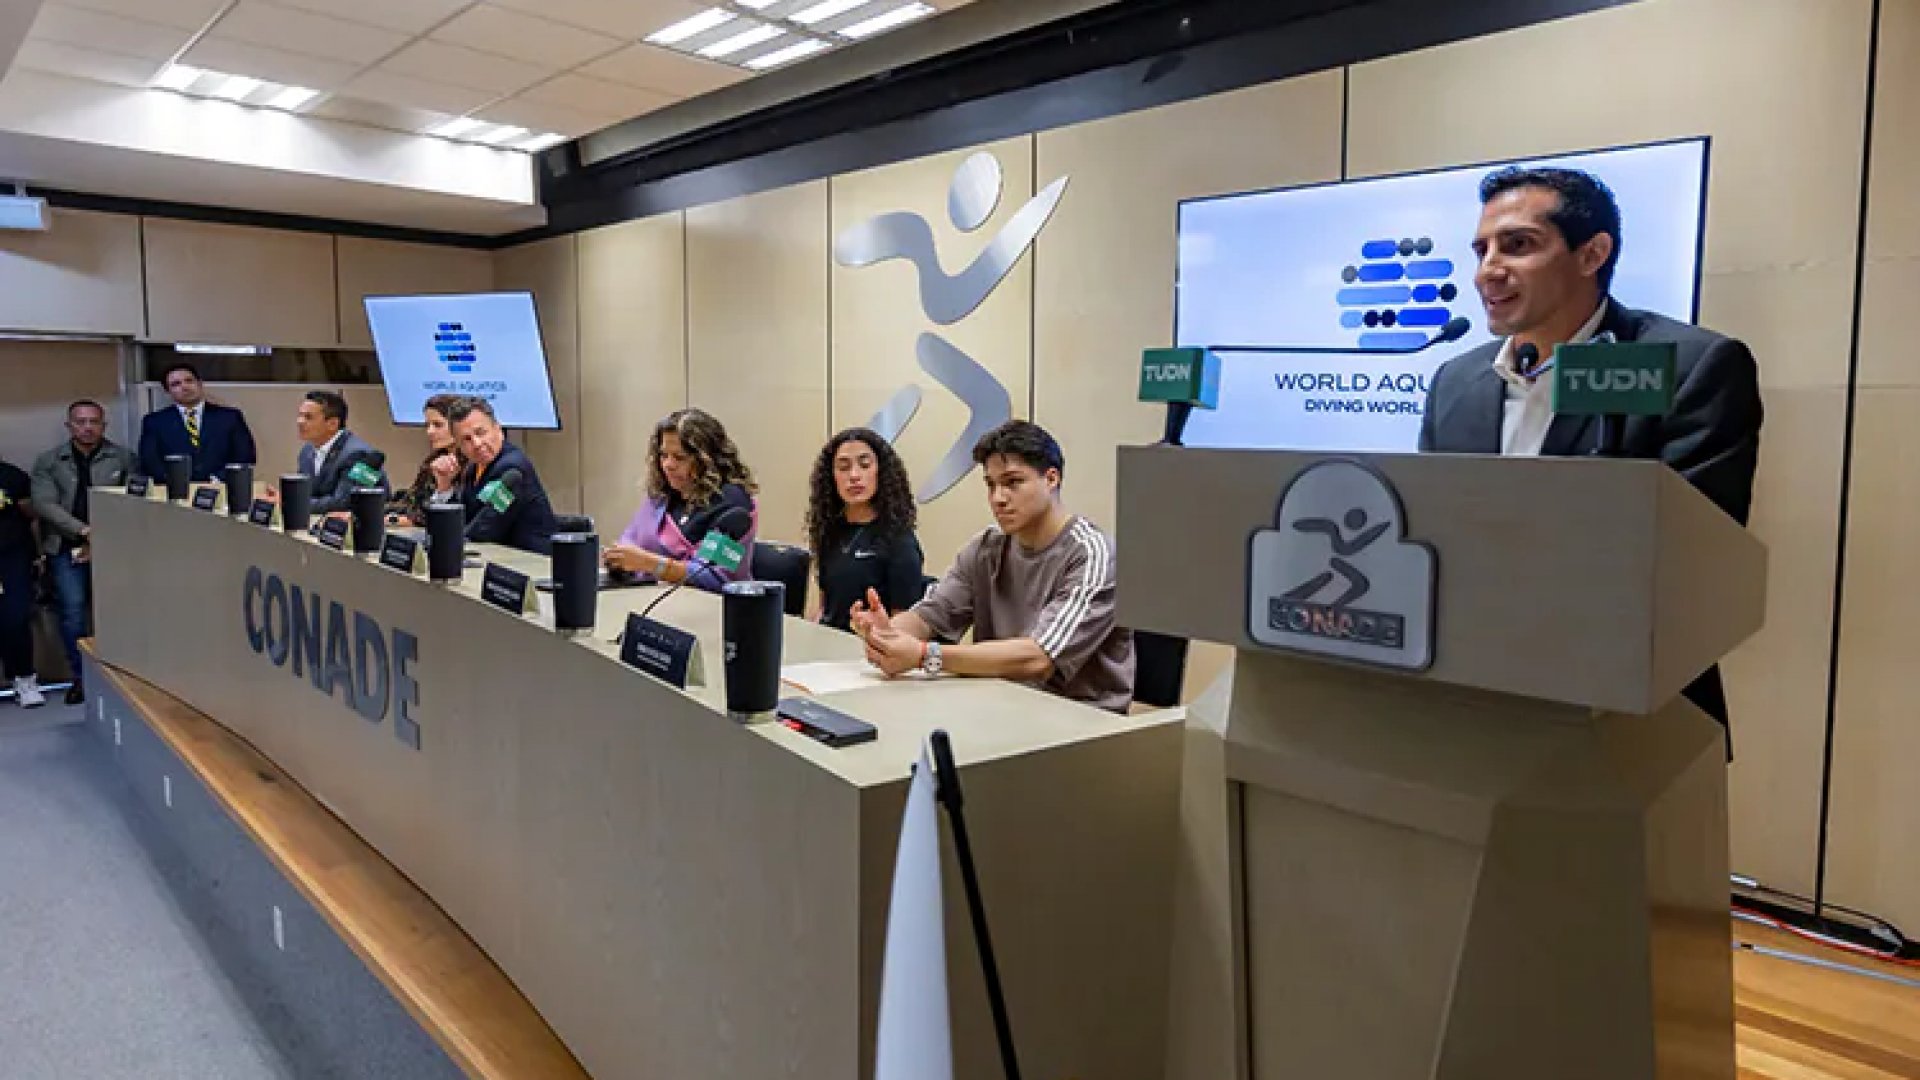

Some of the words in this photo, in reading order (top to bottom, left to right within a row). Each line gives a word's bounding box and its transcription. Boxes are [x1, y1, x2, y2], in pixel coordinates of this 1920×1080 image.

[1144, 363, 1191, 382] TUDN
[1563, 368, 1664, 391] TUDN
[1274, 373, 1371, 392] WORLD
[1305, 398, 1364, 413] DIVING
[1366, 400, 1424, 415] WORL
[244, 566, 421, 750] CONADE
